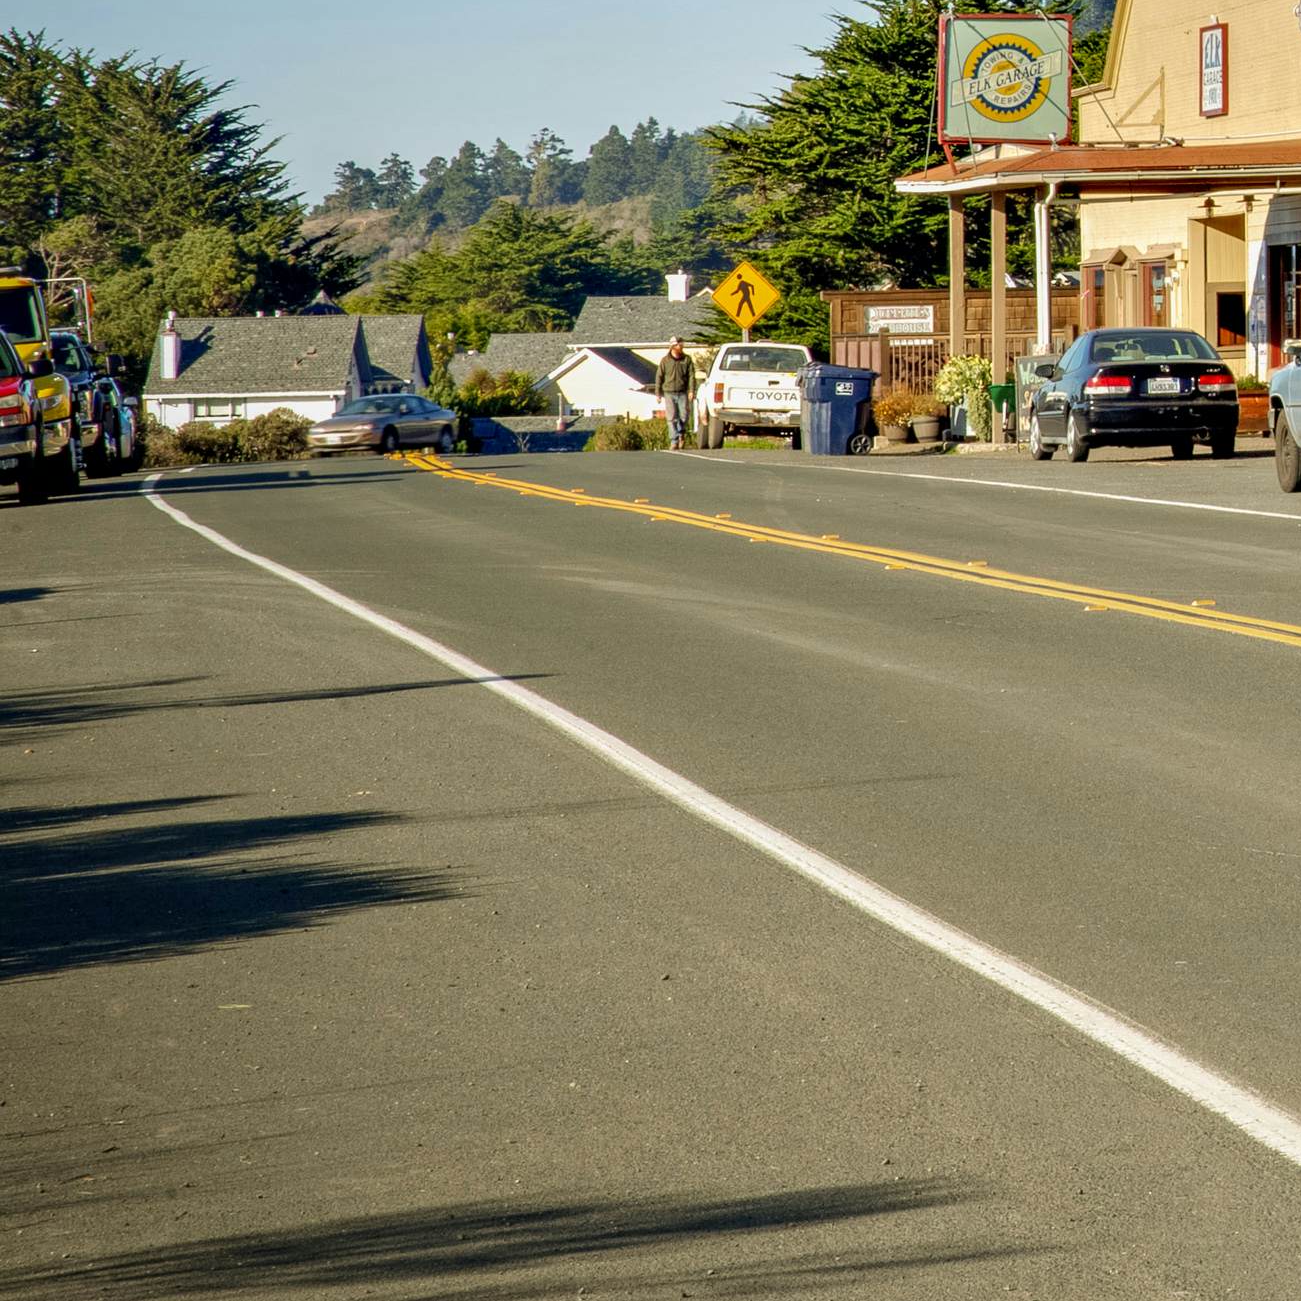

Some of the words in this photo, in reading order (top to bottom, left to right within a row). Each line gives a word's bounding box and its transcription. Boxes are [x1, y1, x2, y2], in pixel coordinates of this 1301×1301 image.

[1204, 32, 1221, 69] ELK
[980, 51, 1014, 73] TOWING
[968, 79, 992, 96] ELK
[996, 60, 1046, 87] GARAGE
[993, 83, 1032, 105] REPAIRS
[748, 391, 798, 401] TOYOTA
